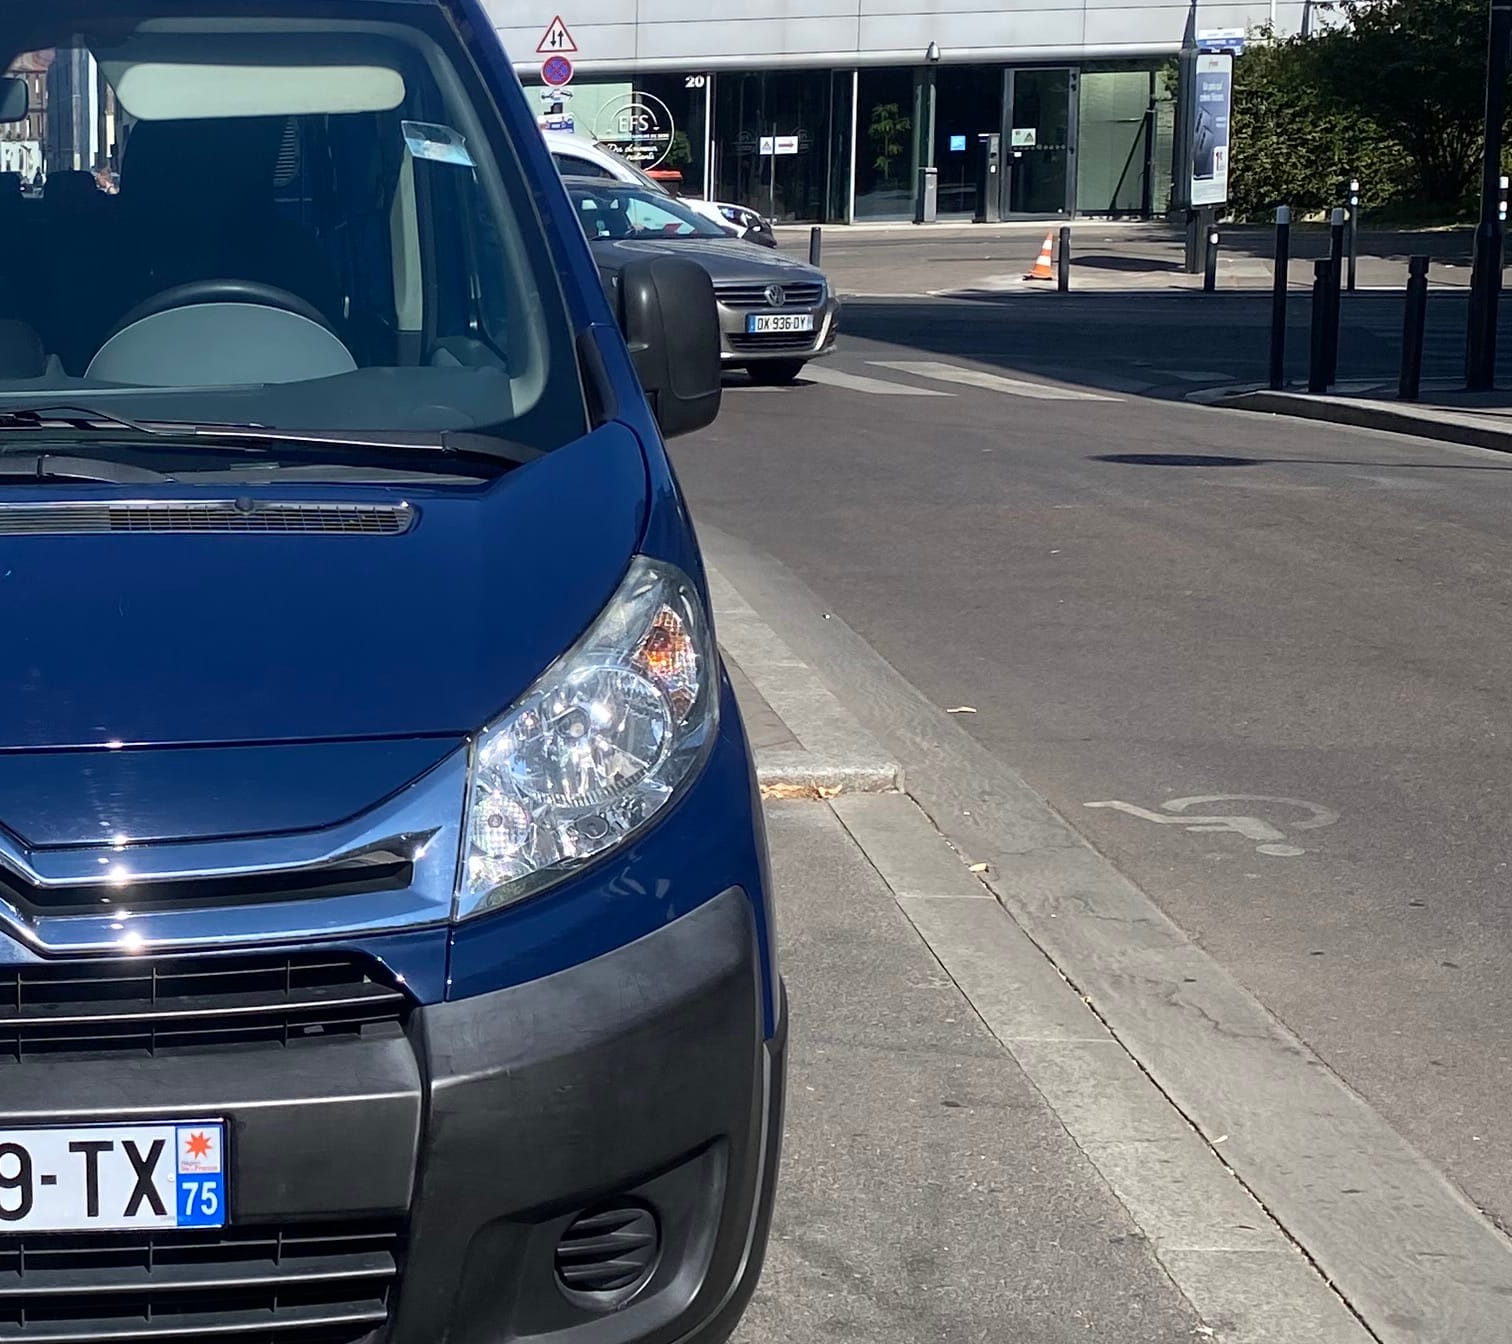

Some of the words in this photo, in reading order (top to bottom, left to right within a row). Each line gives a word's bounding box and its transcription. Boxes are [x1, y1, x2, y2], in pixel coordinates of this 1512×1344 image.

[684, 76, 705, 88] 20
[618, 114, 649, 132] EFS
[181, 1181, 218, 1216] 75
